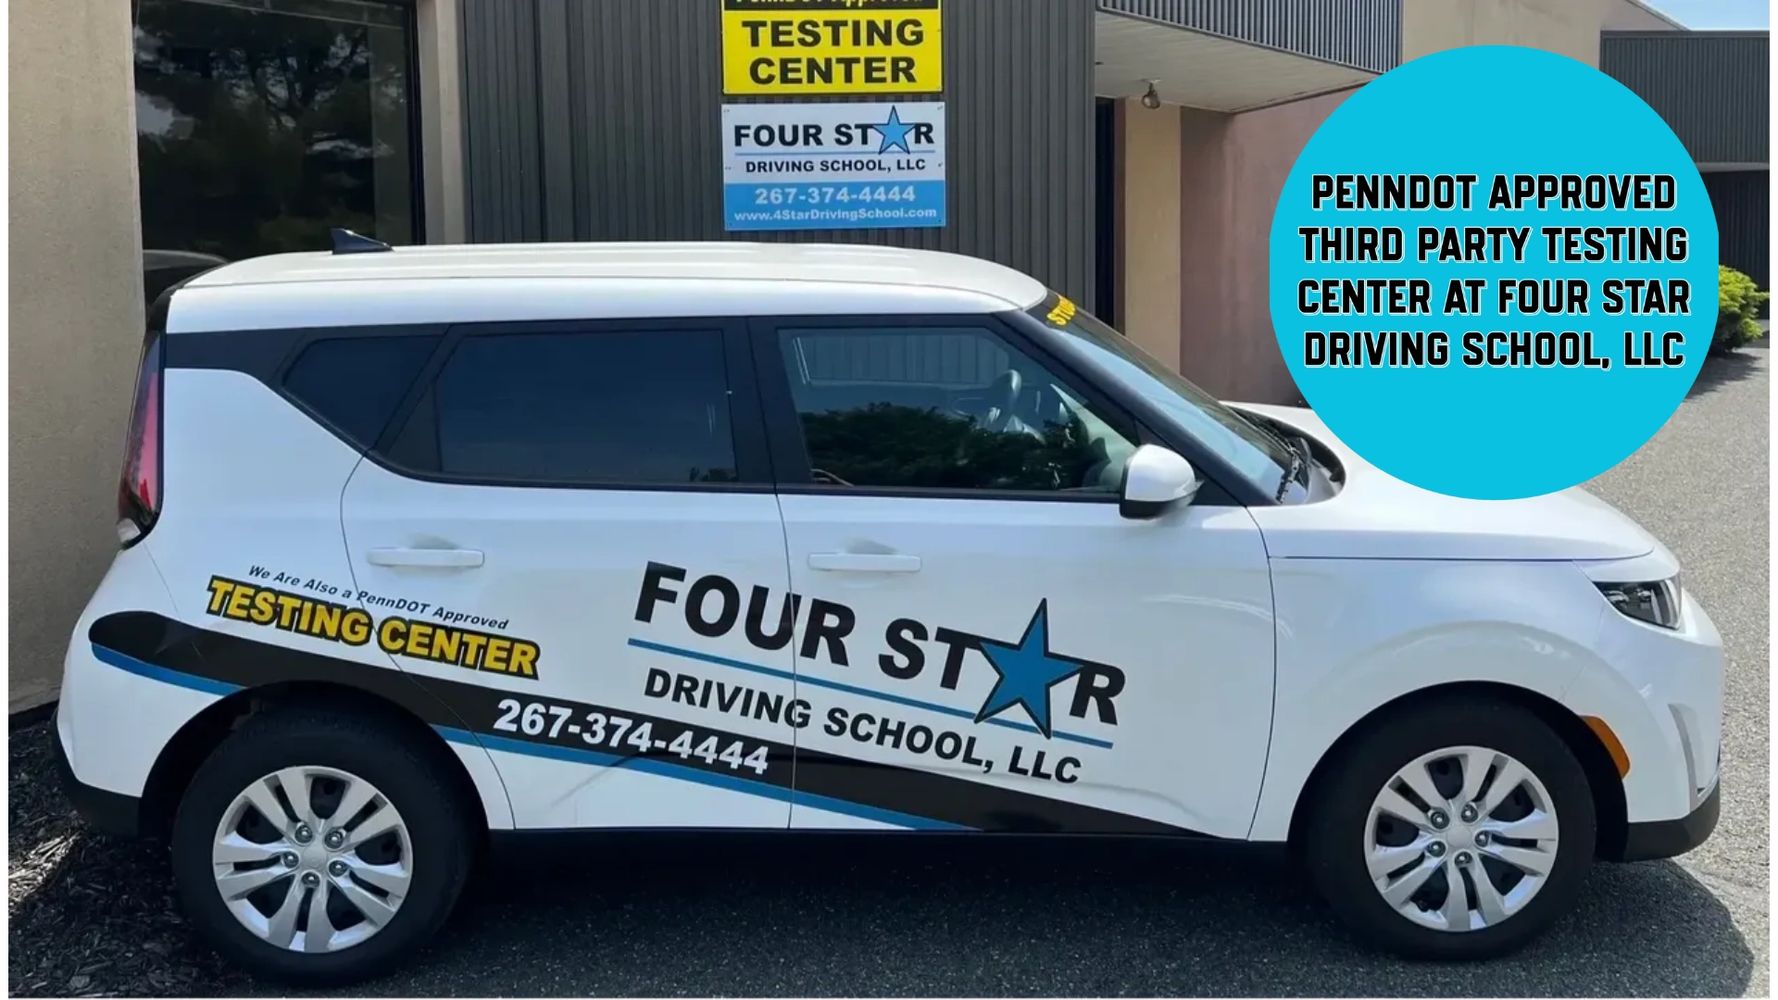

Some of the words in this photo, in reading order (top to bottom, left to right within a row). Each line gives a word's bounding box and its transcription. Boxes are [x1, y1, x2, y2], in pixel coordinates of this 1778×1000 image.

[741, 19, 924, 47] TESTING
[749, 57, 917, 85] CENTER
[734, 124, 823, 147] FOUR
[834, 105, 935, 155] STR
[745, 160, 814, 173] DRIVING
[820, 159, 892, 173] SCHOOL,
[896, 159, 926, 171] LLC
[734, 208, 937, 221] www.4StarDrivingSchool.com
[755, 185, 916, 205] 267-374-4444
[249, 565, 270, 579] We
[273, 570, 301, 587] Are
[303, 578, 338, 596] Also
[341, 589, 352, 600] a
[357, 590, 430, 614] PennDOT
[432, 606, 509, 631] Approved
[207, 575, 374, 646] TESTING
[376, 615, 541, 680] CENTER
[634, 561, 856, 667] FOUR
[879, 597, 1126, 740] STR
[493, 698, 769, 776] 267-374-4444
[644, 667, 811, 730] DRIVING
[823, 707, 993, 774] SCHOOL,
[1008, 745, 1082, 784] LLC
